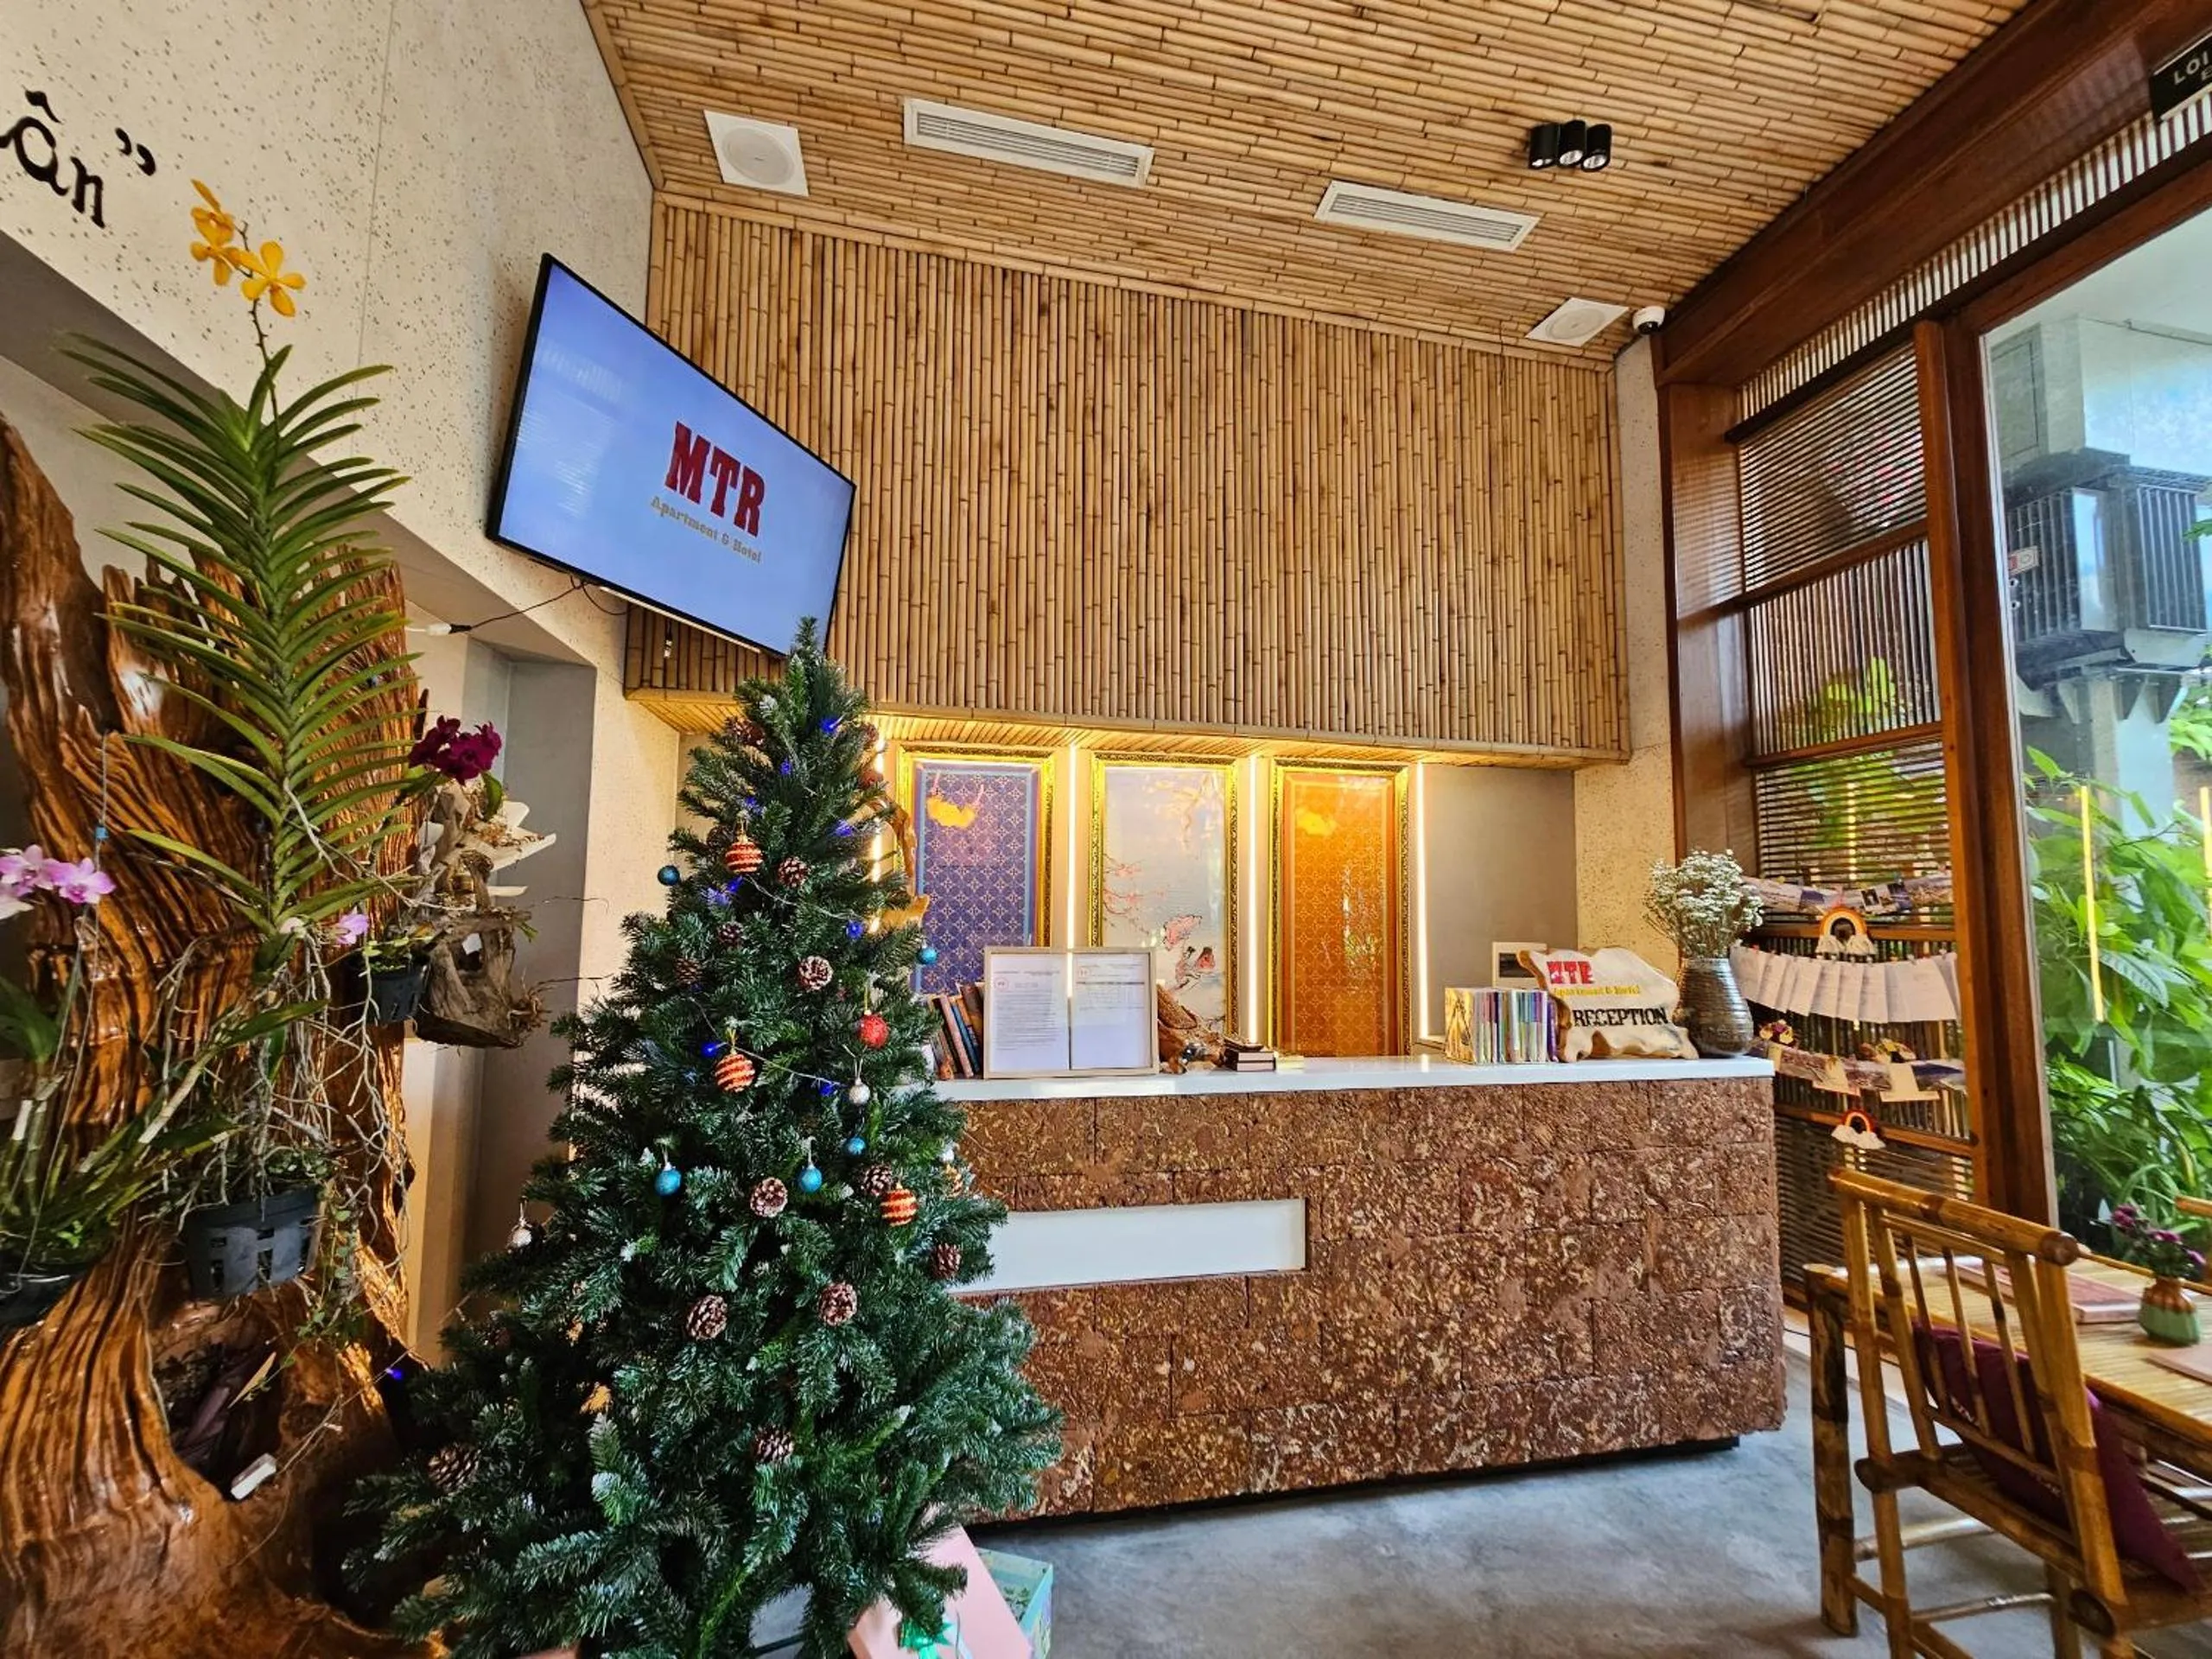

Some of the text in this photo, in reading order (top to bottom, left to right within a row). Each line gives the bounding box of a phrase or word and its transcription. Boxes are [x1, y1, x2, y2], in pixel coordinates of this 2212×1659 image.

[664, 420, 766, 538] MTR
[651, 495, 718, 541] Apartment
[1572, 1007, 1669, 1027] RECEPTION
